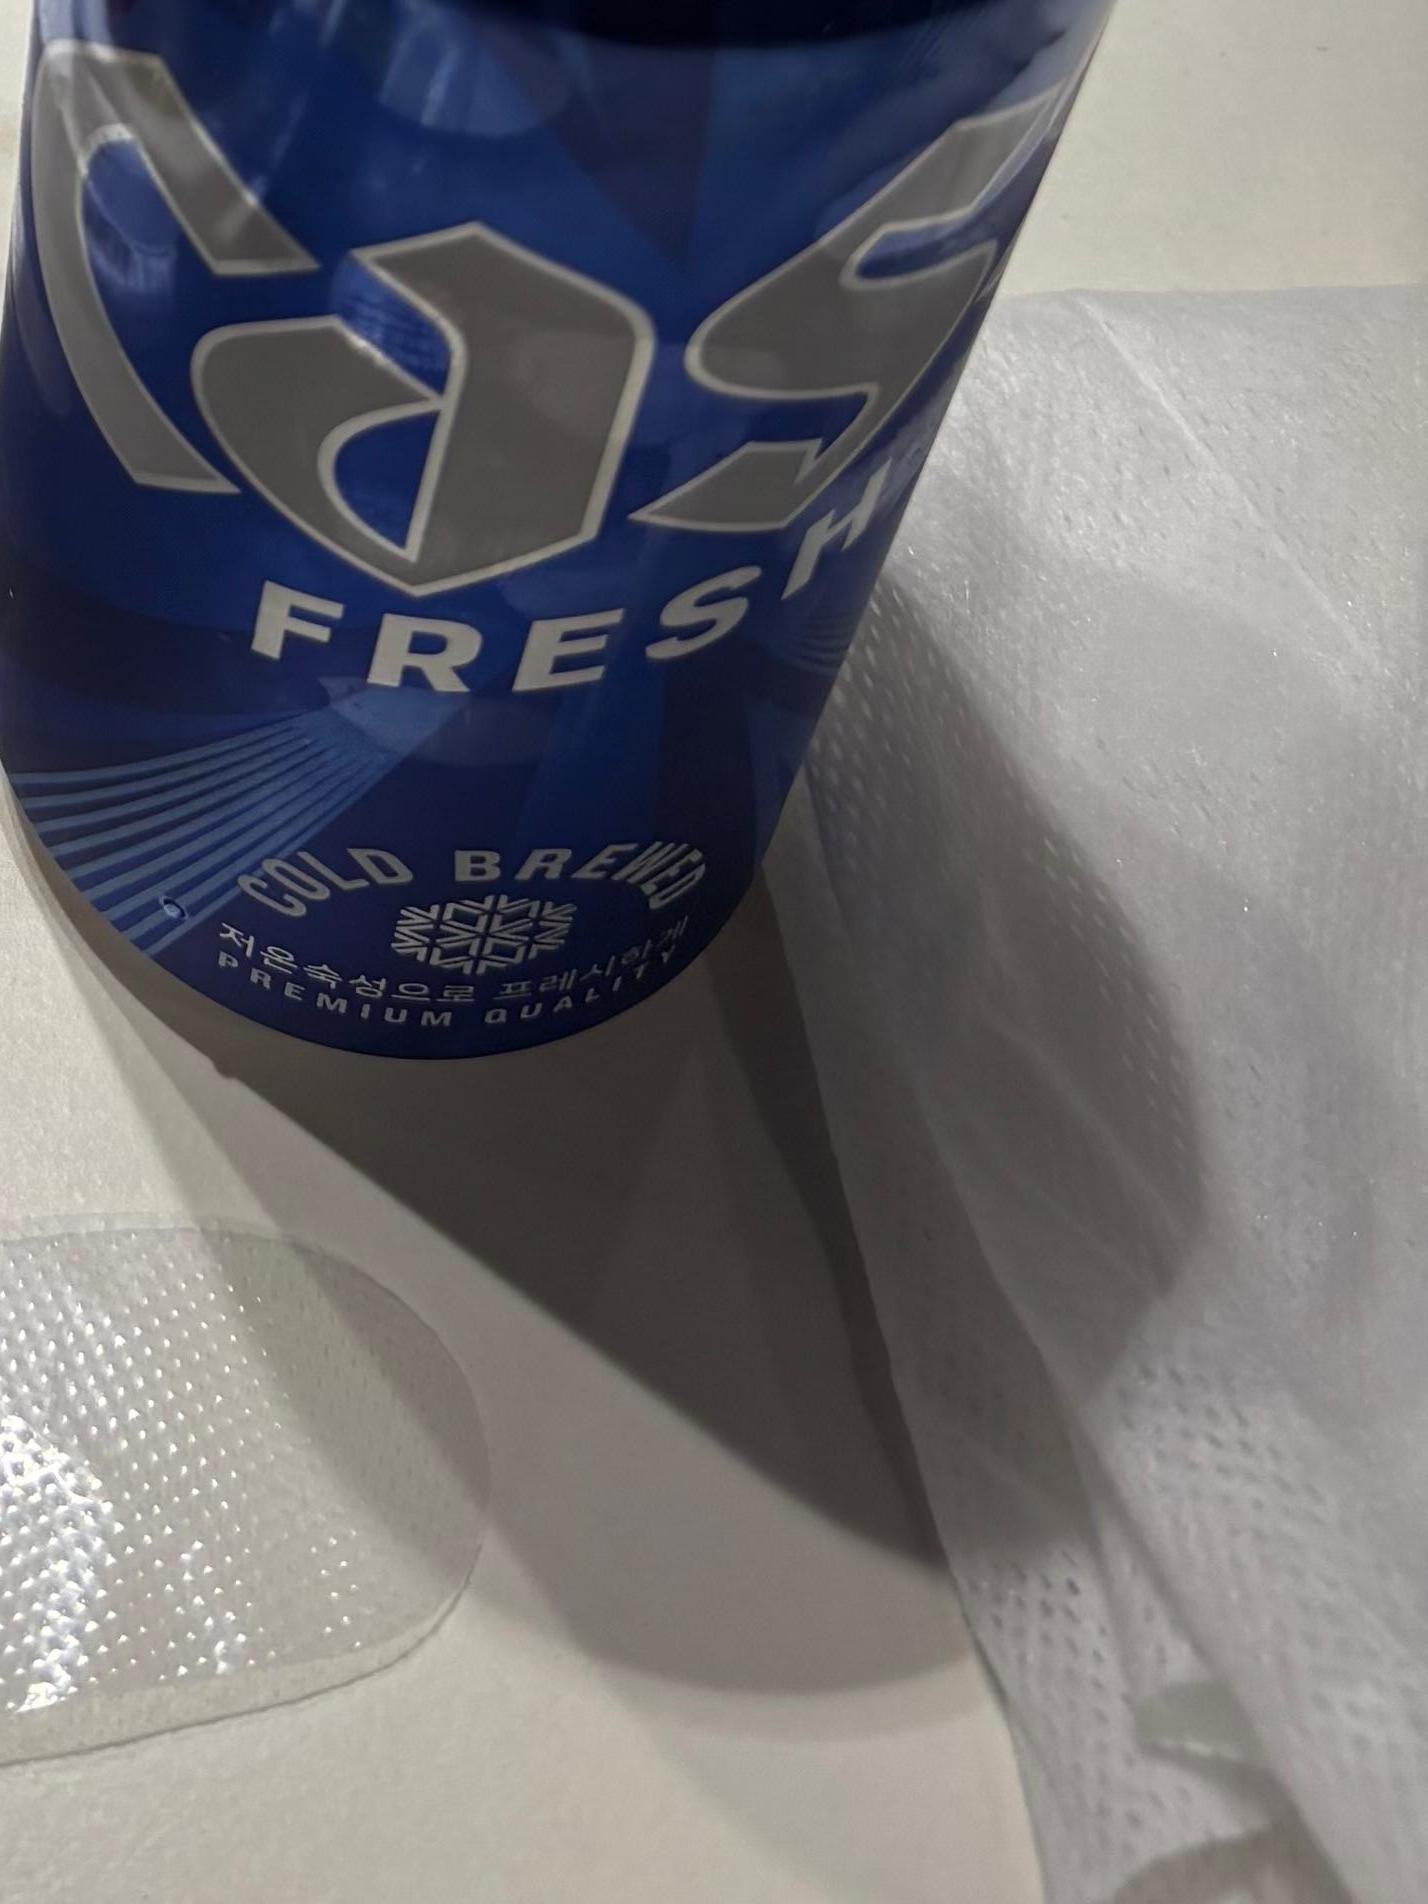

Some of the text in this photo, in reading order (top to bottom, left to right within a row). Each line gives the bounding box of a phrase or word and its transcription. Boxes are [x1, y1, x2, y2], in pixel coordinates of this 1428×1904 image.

[250, 458, 892, 694] FRESH
[237, 840, 707, 918] COLD BREWED
[217, 943, 677, 1027] PREMIUM QUALITY
[219, 921, 475, 1003] 저온숙성으로
